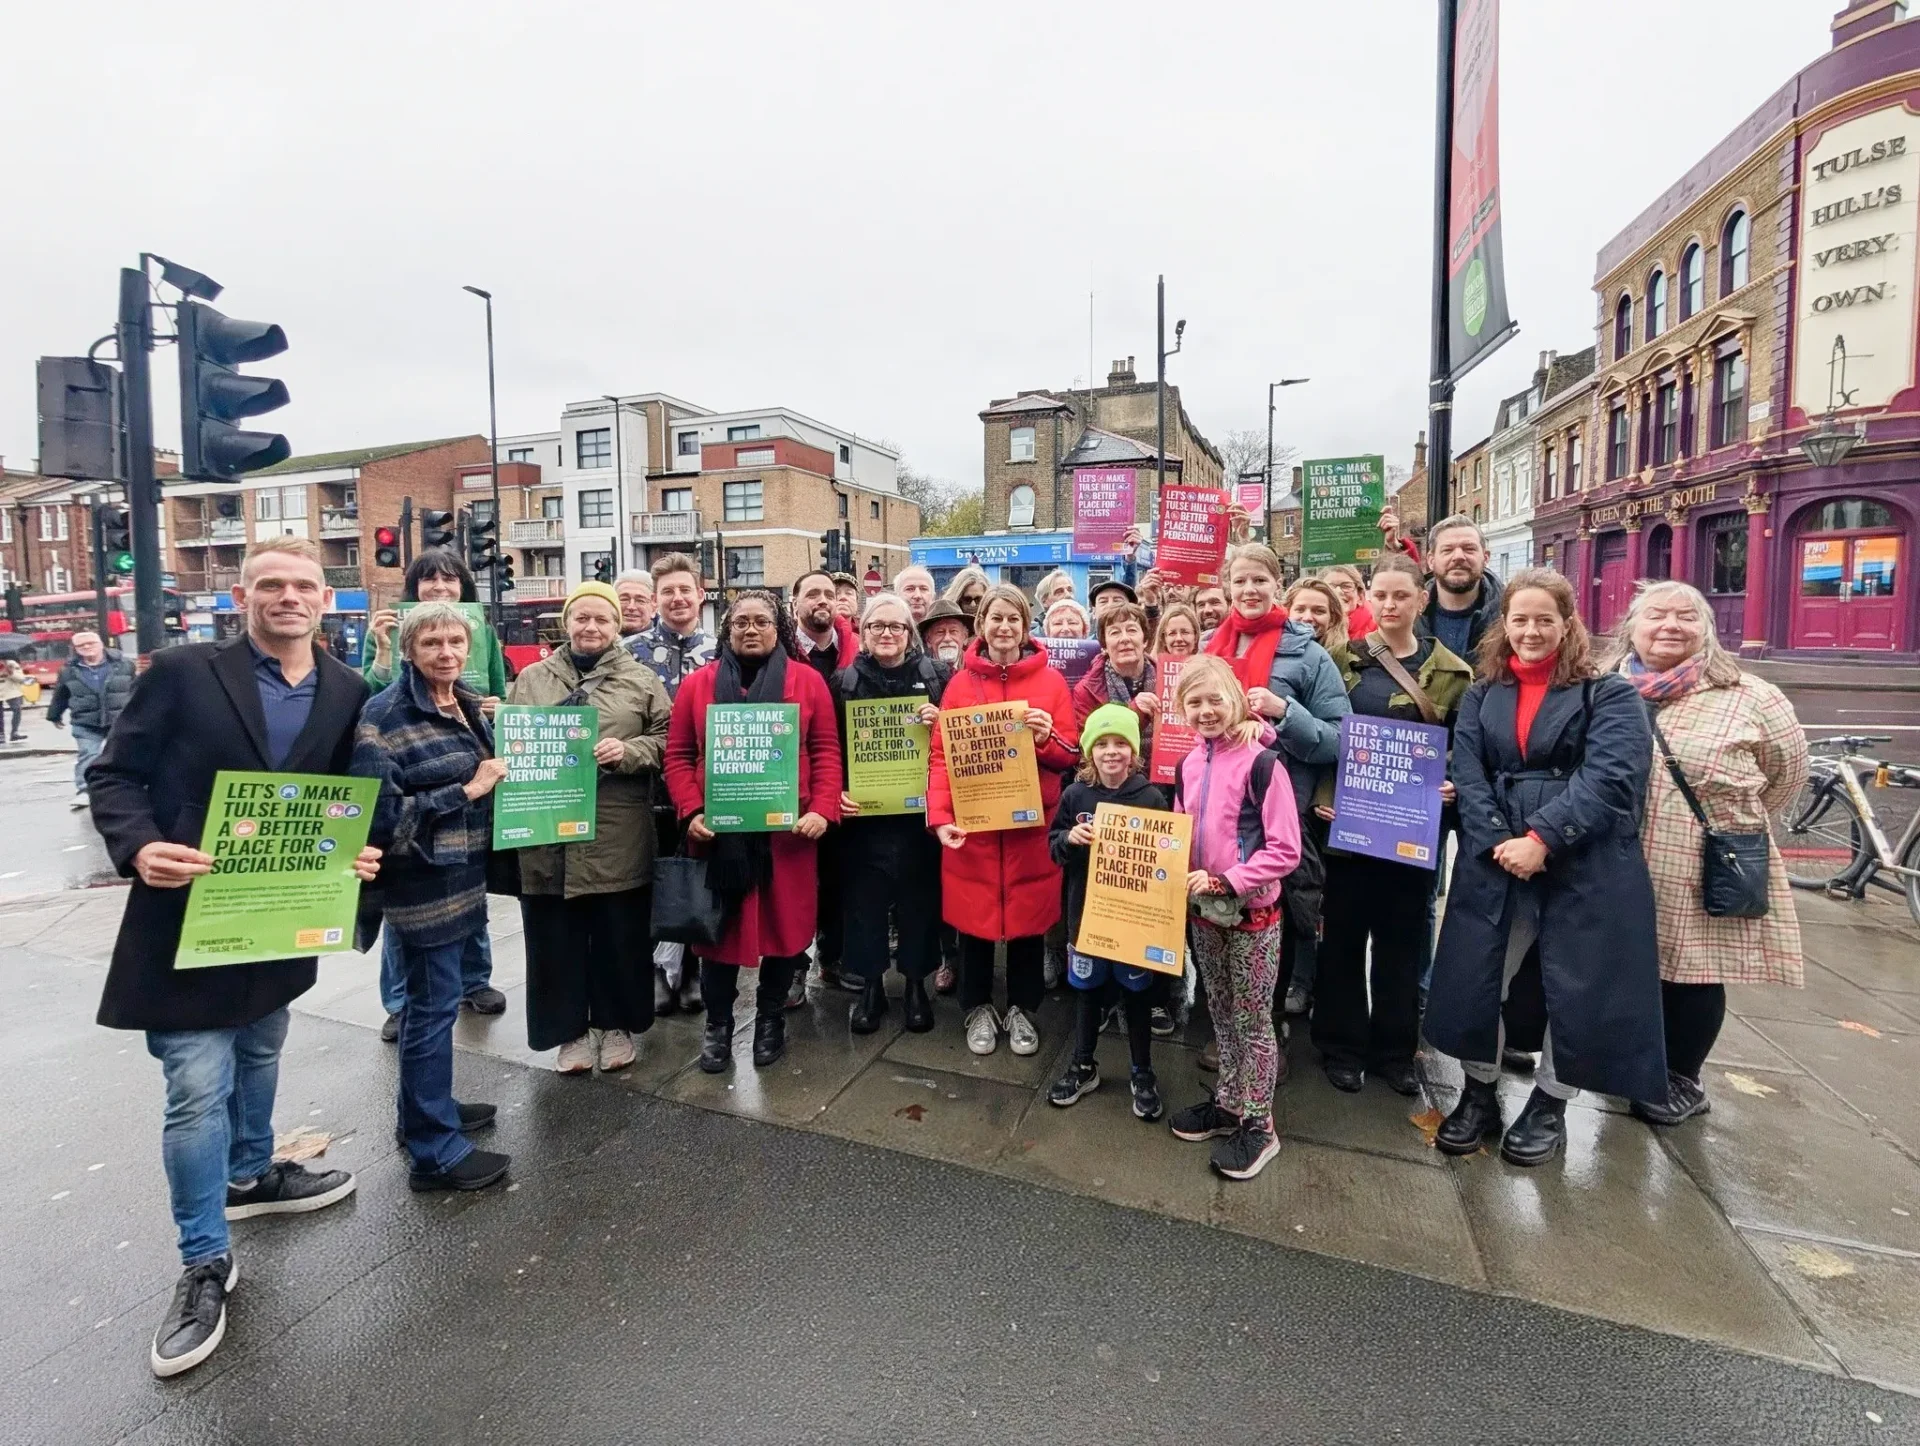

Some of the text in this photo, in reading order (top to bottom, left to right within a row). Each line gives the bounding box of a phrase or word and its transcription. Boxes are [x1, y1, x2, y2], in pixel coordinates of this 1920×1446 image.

[1811, 136, 1907, 181] TULSE
[1811, 184, 1902, 227] HILL'S
[1813, 233, 1895, 268] VERY
[1811, 282, 1887, 313] OWN
[1310, 462, 1371, 475] LET'S MAKE
[1079, 475, 1096, 483] LET'S
[1310, 475, 1360, 487] TULSE HILL
[1079, 483, 1115, 491] TULSE HILL
[1311, 486, 1362, 498] A BETTER
[1079, 492, 1117, 500] A BETTER
[1166, 491, 1220, 503] LET'S MAKE
[1166, 501, 1207, 512] TULSE HILL
[1311, 497, 1360, 509] PLACE FOR
[1591, 484, 1715, 528] QUEEN OF THE SOUTH
[1079, 509, 1110, 517] CYCLISTS
[1181, 513, 1208, 522] BETTER
[1310, 508, 1357, 520] EVERYONE
[1164, 521, 1205, 533] PLACE FOR
[1163, 530, 1214, 544] PEDESTRIANS
[1048, 639, 1078, 648] BETTER
[1059, 649, 1076, 659] FOR
[715, 711, 784, 722] LET'S MAKE
[853, 703, 914, 717] LET'S MAKE
[504, 714, 582, 726] LET'S MAKE
[853, 716, 903, 728] TULSE HILL
[946, 709, 1014, 728] LET'S MAKE
[503, 728, 565, 739] TULSE HILL
[714, 724, 770, 735] TULSE HILL
[854, 728, 905, 740] A BETTER
[948, 724, 1002, 741] TULSE HILL
[1350, 722, 1429, 745] LET'S MAKE
[504, 742, 566, 754] A BETTER
[714, 737, 772, 748] A BETTER
[854, 739, 903, 752] PLACE FOR
[951, 737, 1006, 754] A BETTER
[1349, 735, 1411, 756] TULSE HILL
[505, 755, 563, 768] PLACE FOR
[713, 749, 769, 761] PLACE FOR
[855, 750, 920, 763] ACCESSIBILITY
[952, 749, 1005, 766] PLACE FOR
[1347, 749, 1412, 770] A BETTER
[713, 762, 765, 774] EVERYONE
[954, 762, 1003, 778] CHILDREN
[1346, 762, 1408, 783] PLACE FOR
[1345, 776, 1394, 794] DRIVERS
[227, 783, 352, 801] LET'S MAKE
[224, 802, 323, 818] TULSE HILL
[218, 821, 324, 837] A BETTER
[1102, 813, 1174, 834] LET'S MAKE
[1100, 827, 1156, 848] TULSE HILL
[214, 839, 315, 856] PLACE FOR
[1097, 842, 1157, 864] A BETTER
[210, 855, 326, 874] SOCIALISING
[1096, 857, 1153, 879] PLACE FOR
[1096, 872, 1148, 893] CHILDREN
